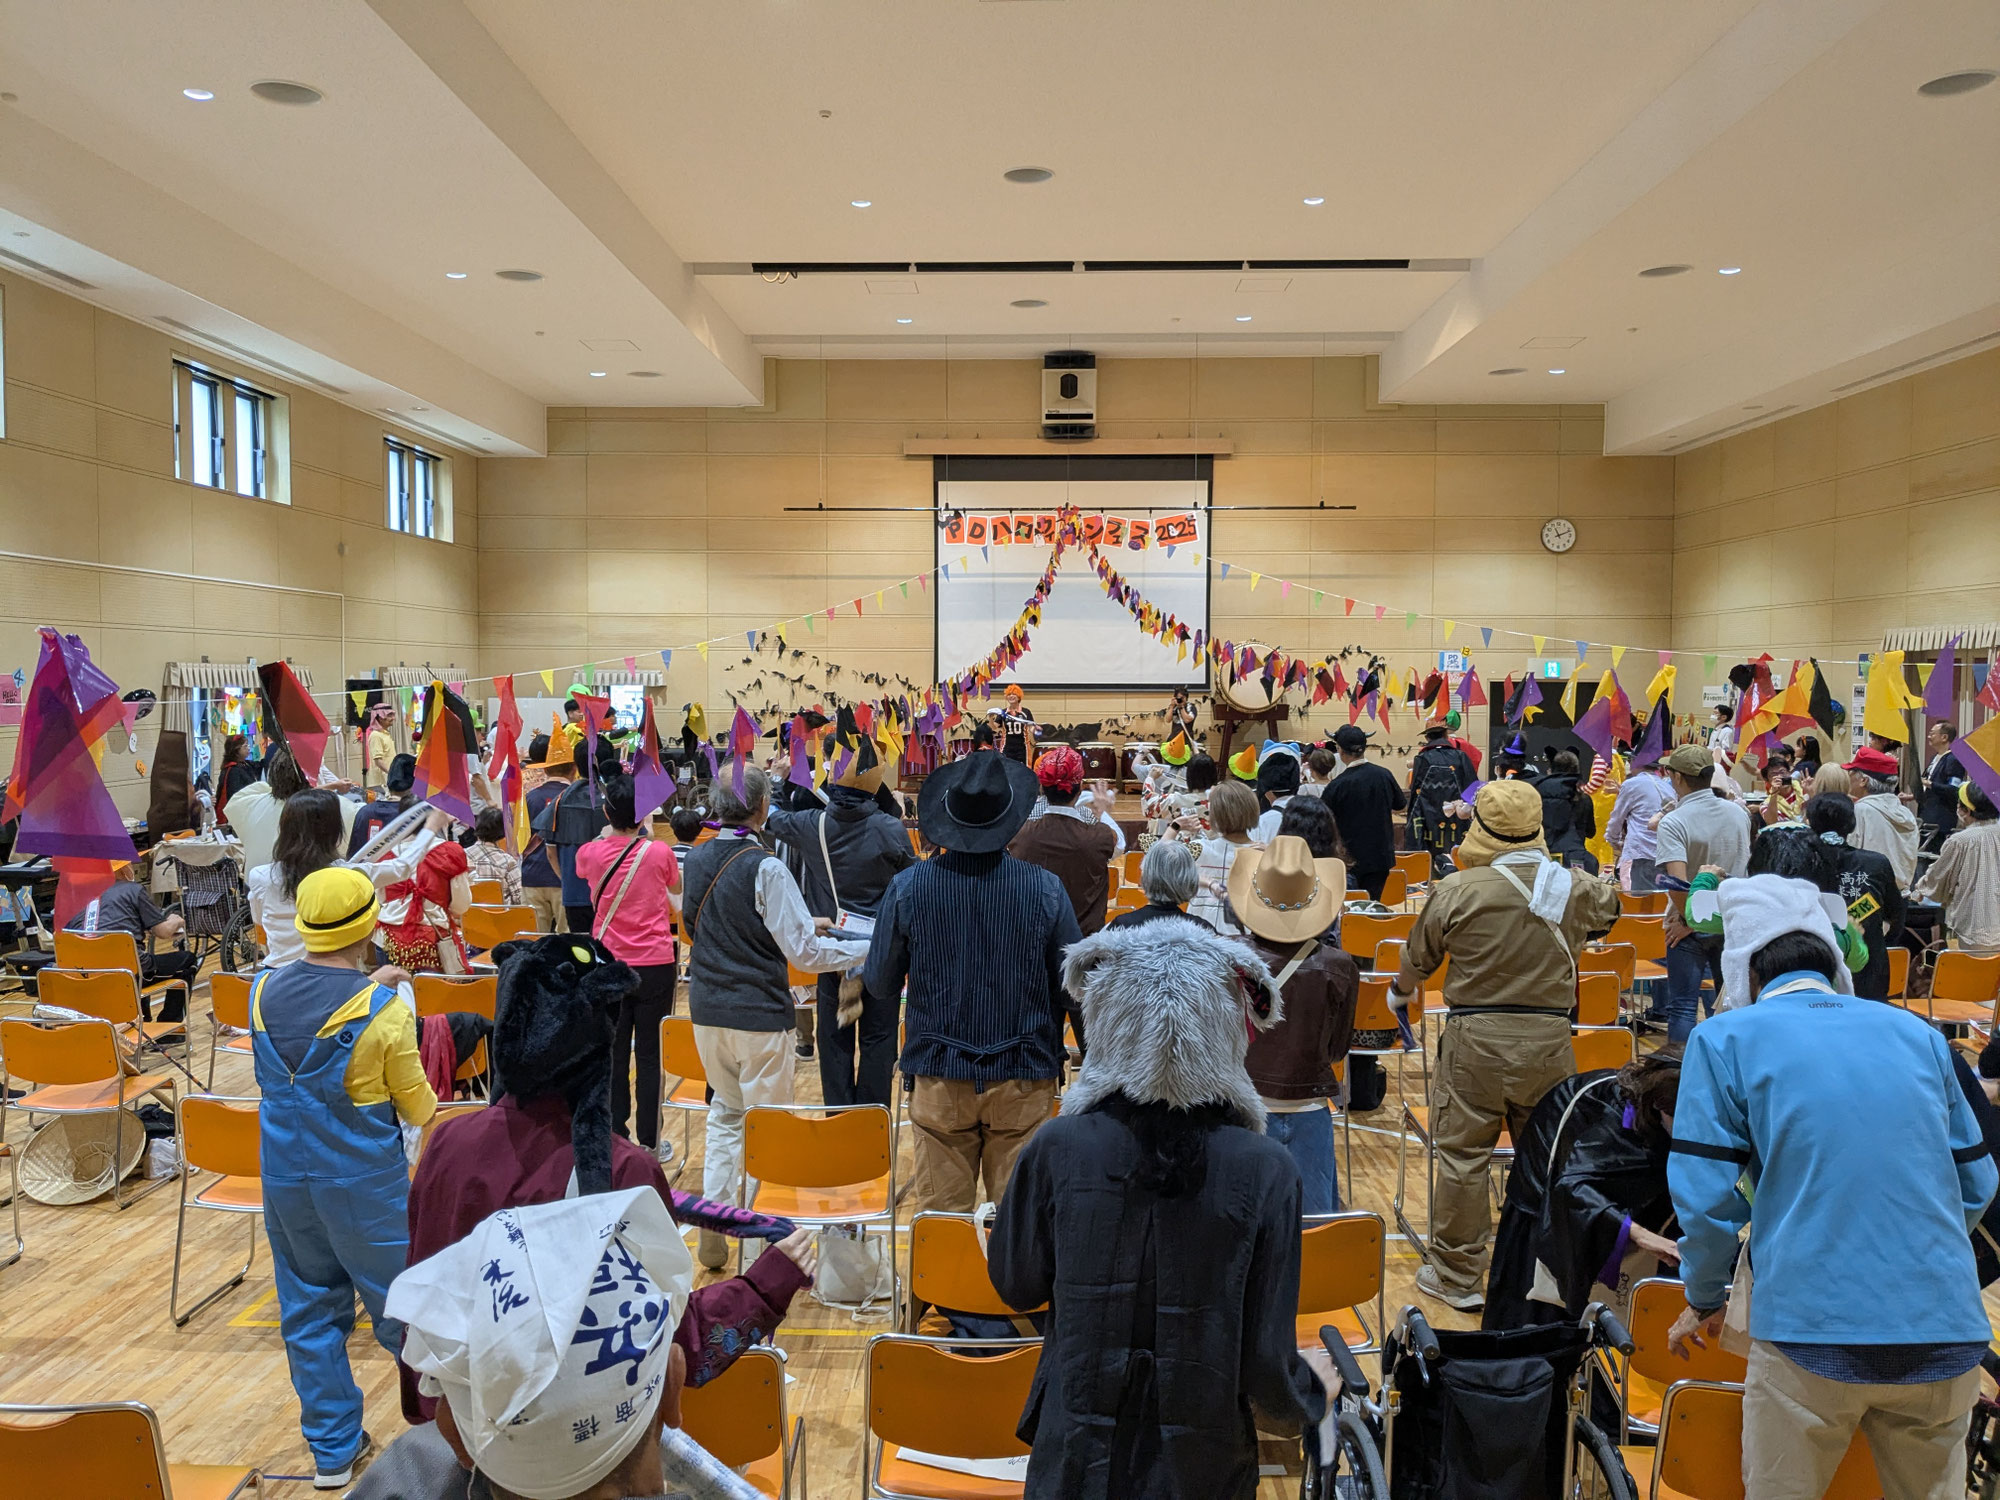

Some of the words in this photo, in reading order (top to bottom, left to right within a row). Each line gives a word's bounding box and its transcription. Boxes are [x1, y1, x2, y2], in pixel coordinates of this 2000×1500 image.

[14, 669, 23, 687] 4
[1007, 721, 1021, 734] 10
[1413, 817, 1467, 848] Fuji
